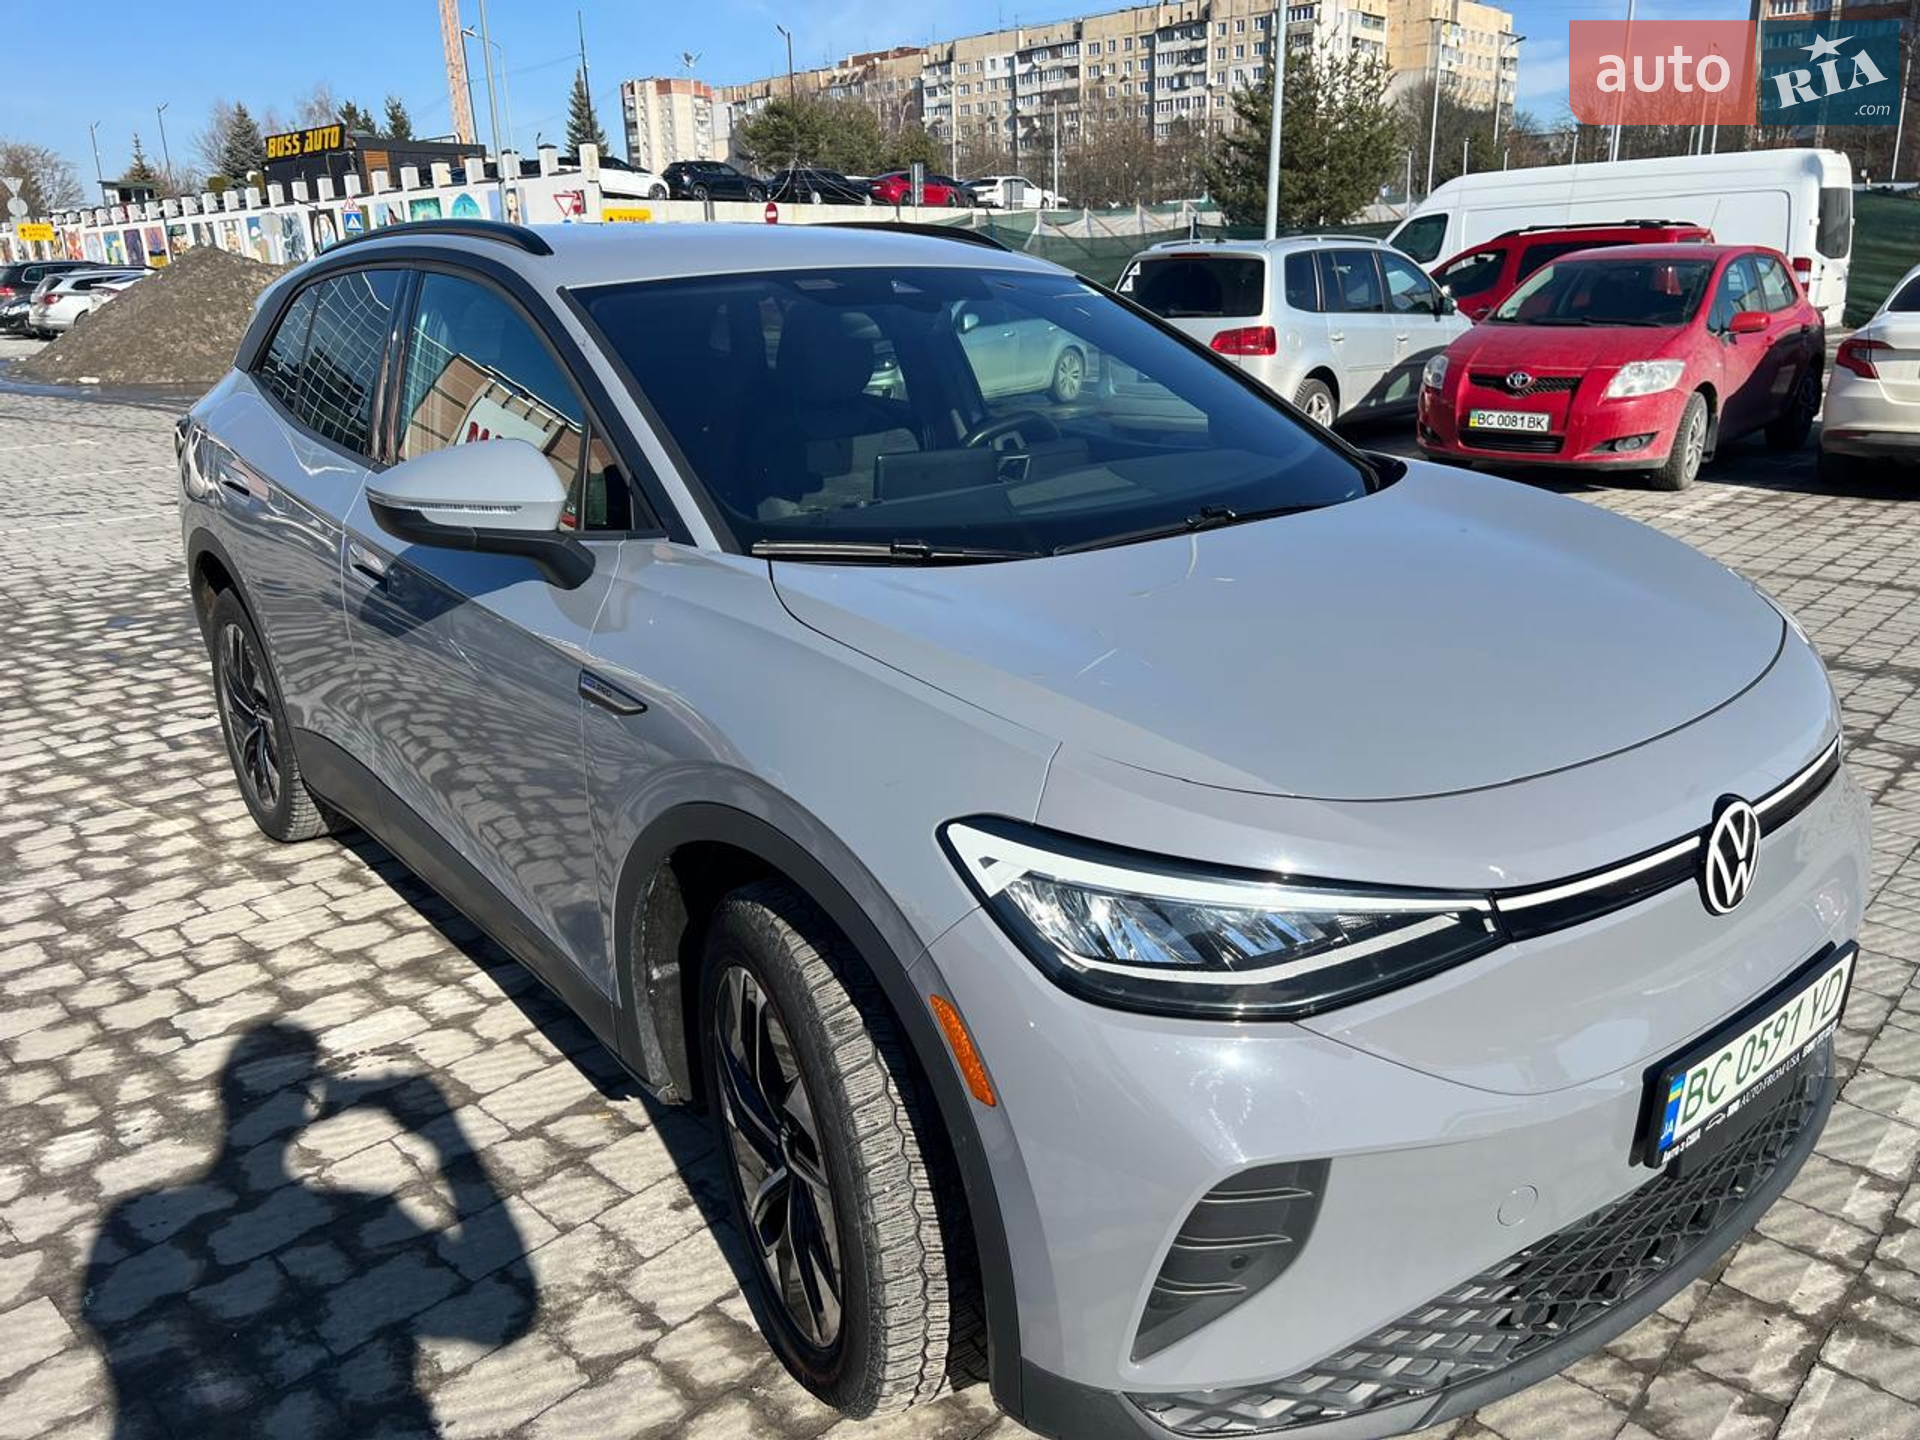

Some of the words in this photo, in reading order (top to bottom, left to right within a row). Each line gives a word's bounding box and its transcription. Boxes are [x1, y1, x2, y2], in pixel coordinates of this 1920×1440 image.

[267, 133, 300, 158] BOSS
[303, 126, 340, 153] AUTO
[1478, 412, 1494, 426] BC
[1497, 414, 1525, 429] 0081
[1528, 416, 1545, 430] BK
[1681, 1051, 1732, 1125] BC
[1736, 998, 1804, 1086] 0591
[1809, 967, 1844, 1031] YD
